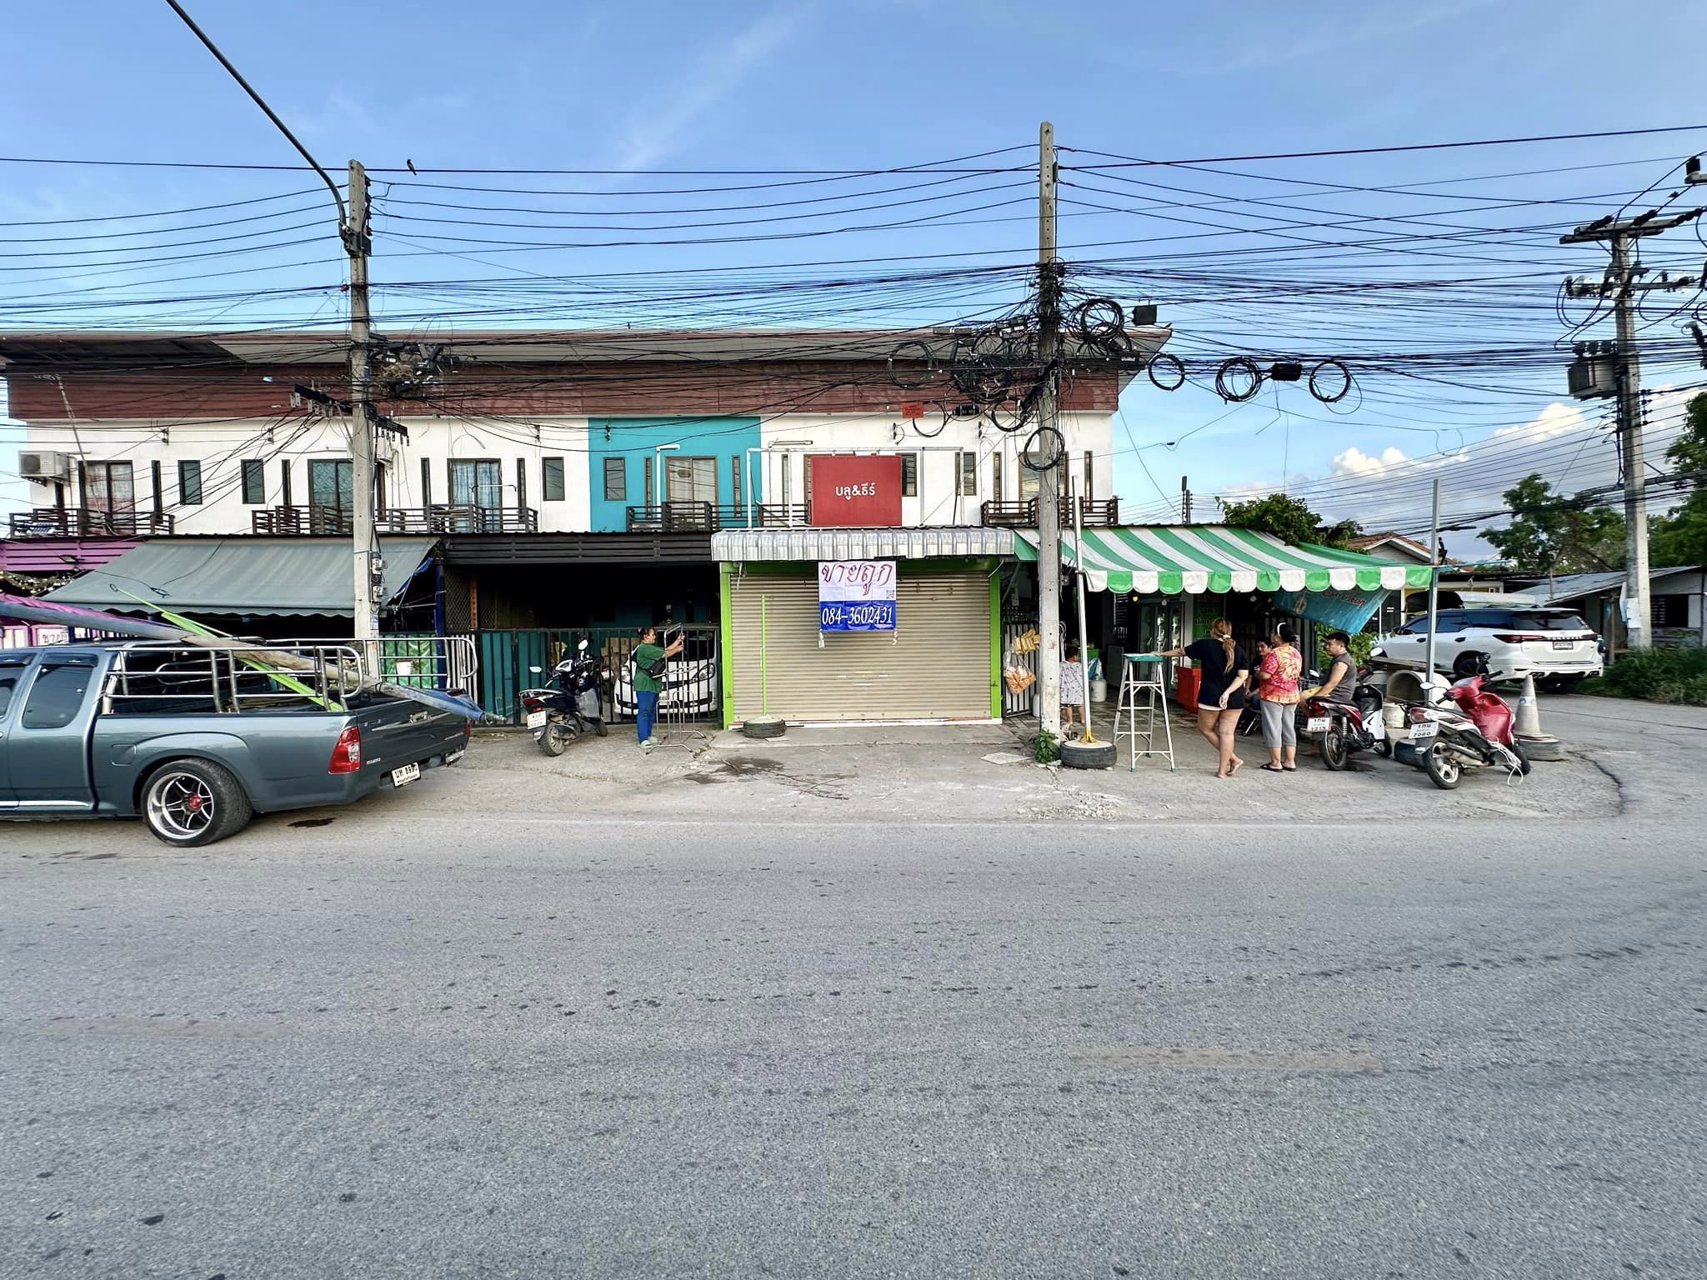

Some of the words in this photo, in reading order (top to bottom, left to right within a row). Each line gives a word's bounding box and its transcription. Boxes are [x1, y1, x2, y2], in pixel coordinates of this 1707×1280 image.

[835, 482, 876, 500] บลู&ธีร์
[821, 562, 893, 596] ขายถูก
[822, 606, 892, 625] 084-3602431
